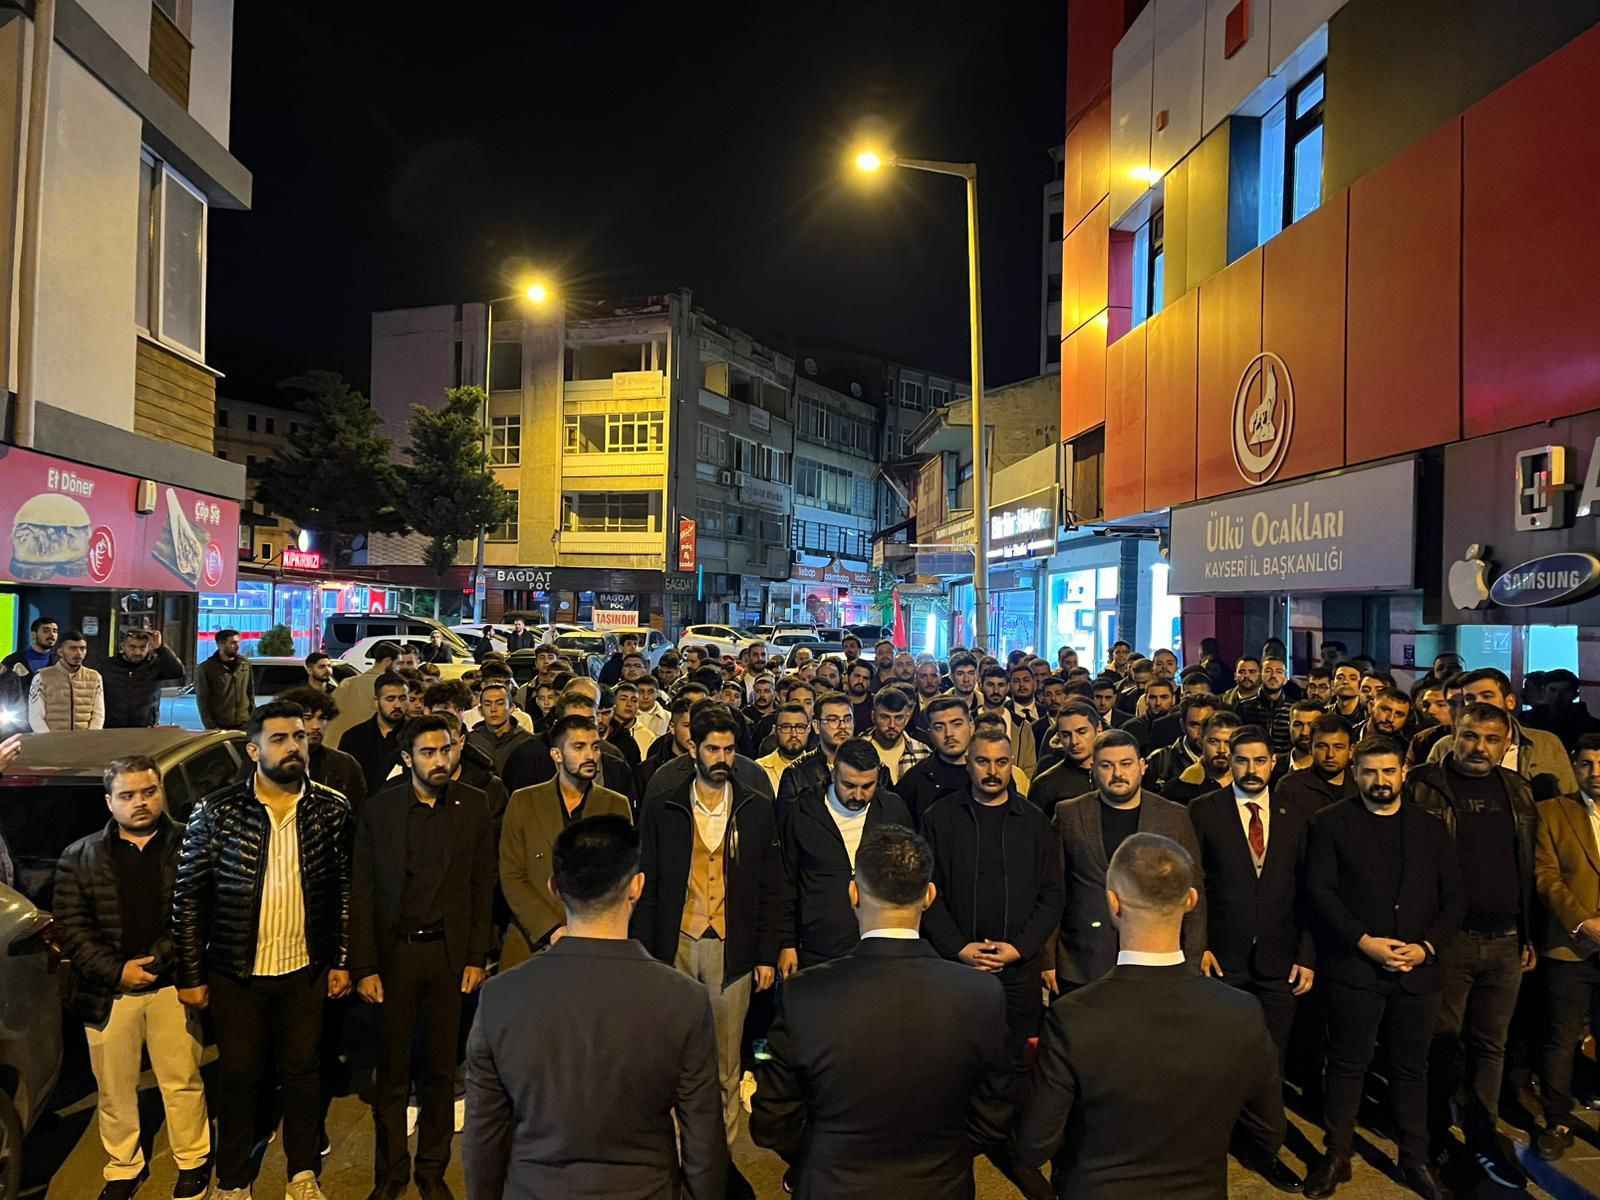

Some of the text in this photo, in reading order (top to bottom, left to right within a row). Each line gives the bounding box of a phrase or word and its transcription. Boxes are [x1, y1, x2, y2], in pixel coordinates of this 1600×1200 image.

[48, 469, 95, 498] Et Döner
[1206, 511, 1244, 552] Ülkü
[1205, 546, 1343, 580] KAYSERİ İL BAŞKANLIĞI
[529, 582, 551, 591] POÇ
[1503, 570, 1580, 591] SAMSUNG
